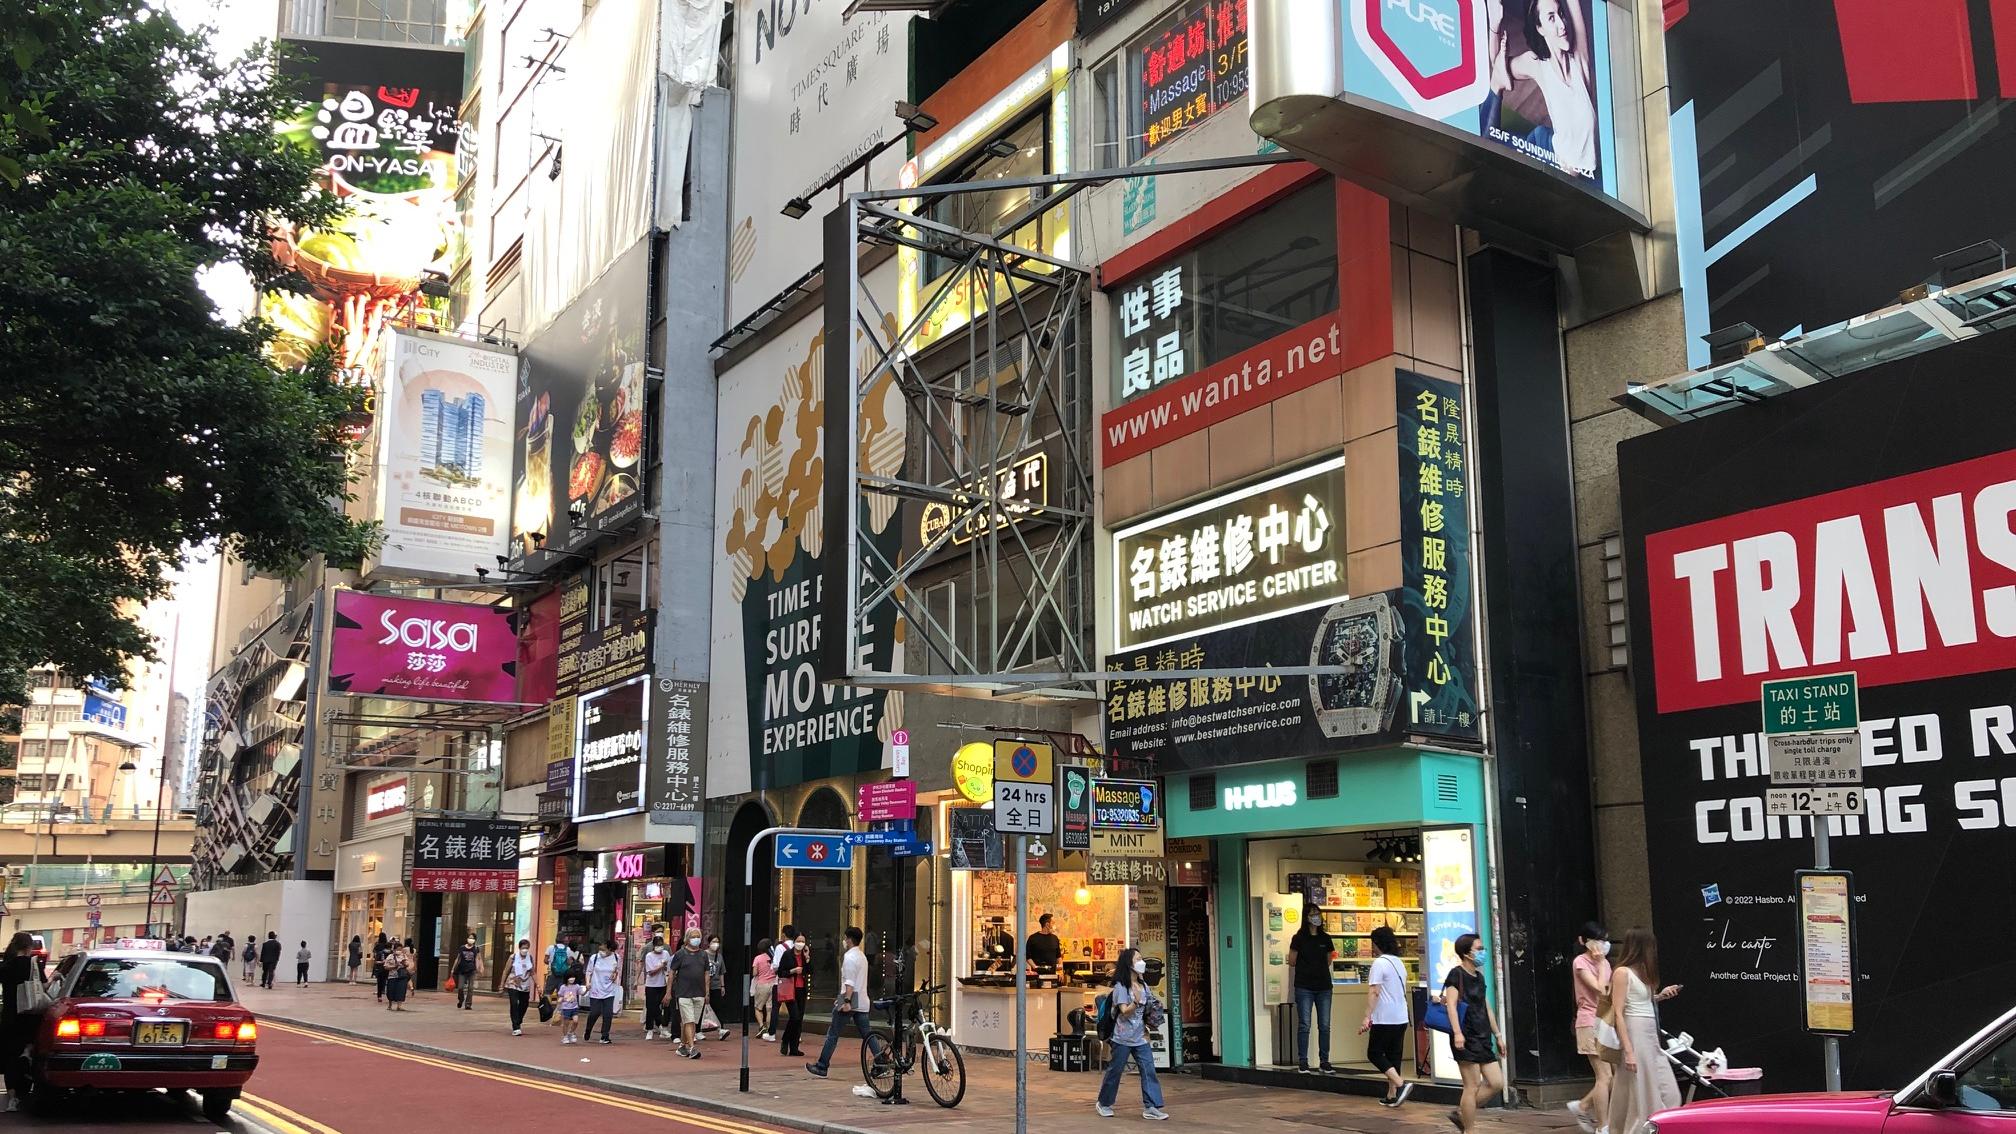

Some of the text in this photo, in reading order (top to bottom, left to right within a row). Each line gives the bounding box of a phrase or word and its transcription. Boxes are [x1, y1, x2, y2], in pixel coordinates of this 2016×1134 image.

[756, 0, 814, 65] NO
[791, 23, 865, 102] TIMES SQUARE
[1147, 20, 1206, 87] 舒適坊
[789, 23, 889, 136] 時代廣場
[1150, 64, 1206, 115] Massage
[1148, 93, 1207, 147] 歡迎男女賓
[1489, 126, 1510, 142] 25/F
[797, 126, 885, 201] MPERORCINEMAS.COM
[1119, 265, 1183, 338] 性事
[1122, 330, 1184, 398] 良品
[1108, 322, 1340, 447] www.wanta.net
[1129, 493, 1332, 602] 名錶維修中心
[1416, 389, 1452, 686] 名錶維修服務中心
[767, 579, 810, 620] TIME
[1129, 559, 1338, 632] WATCH SERVICE CENTER
[407, 651, 447, 673] 莎莎
[381, 675, 469, 693] making life beautiful
[1769, 682, 1849, 702] TAXI STAND
[1109, 698, 1301, 740] Email address: info@bestwatchservice.com
[1780, 702, 1841, 725] 的士站
[763, 703, 874, 755] EXPERIENCE
[1131, 715, 1301, 751] Website: www.bestwatchservice.com
[665, 694, 692, 802] 名錶維修服務中心
[1773, 736, 1854, 747] Cross-harbour trips only
[1804, 746, 1816, 754] toll
[1817, 745, 1841, 754] charge
[1794, 757, 1831, 766] 只限過海
[661, 802, 694, 812] 2217-6699
[1001, 787, 1046, 804] 24 hrs
[1096, 786, 1141, 807] Massage
[1771, 801, 1843, 812] 中午 上午
[1847, 791, 1858, 811] 6
[1006, 807, 1042, 828] 全日
[1066, 811, 1088, 823] Massage
[1140, 814, 1153, 823] 3/F
[418, 834, 518, 860] 名錶維修
[1091, 860, 1167, 881] 名錶維修中心
[416, 877, 516, 891] 手袋維修護理
[1734, 896, 1754, 904] 2022
[1755, 895, 1785, 904] Hasbro.
[1140, 931, 1163, 942] COFFEE
[1721, 919, 1737, 949] la
[1741, 935, 1776, 969] carte
[1710, 971, 1739, 980] Another
[1740, 972, 1762, 981] Great
[1763, 972, 1791, 983] Project
[152, 1023, 170, 1034] FE
[1172, 998, 1182, 1051] Polaroid
